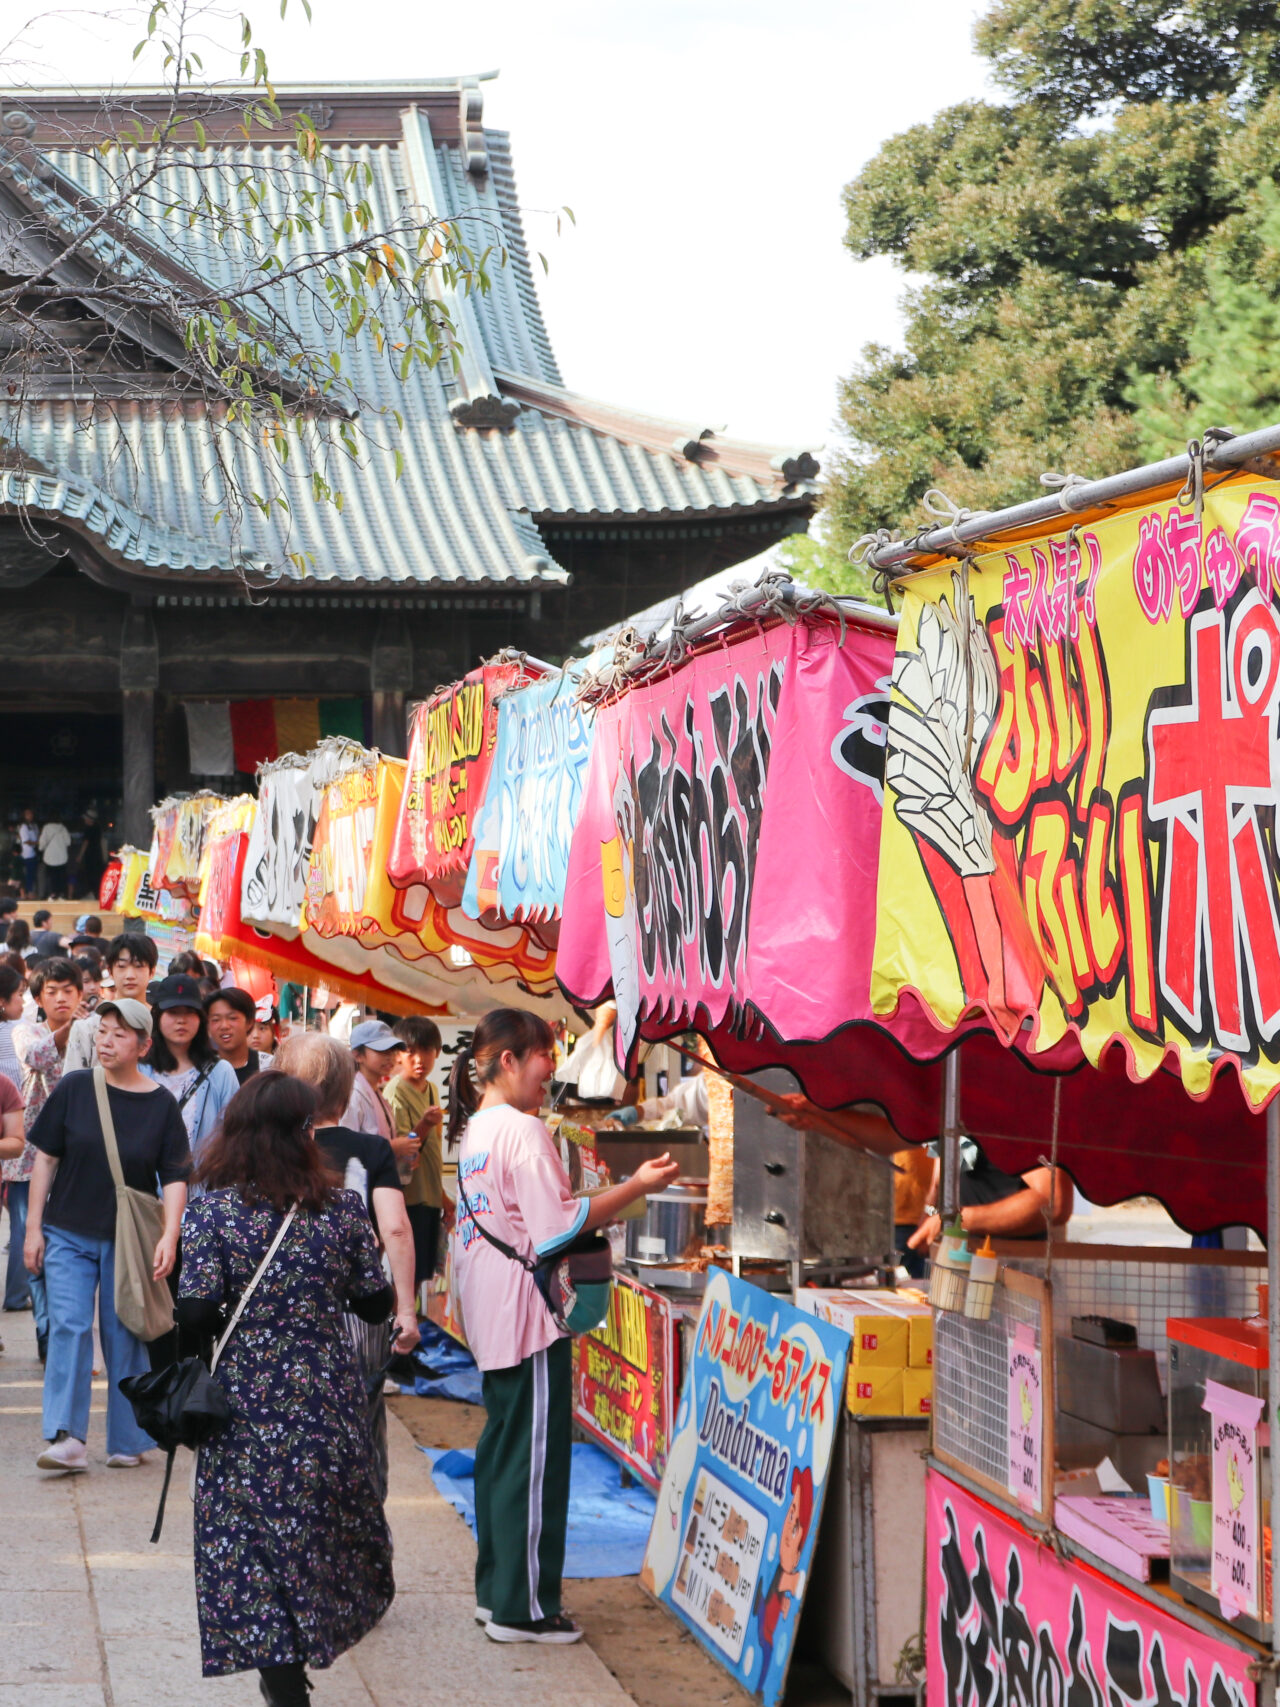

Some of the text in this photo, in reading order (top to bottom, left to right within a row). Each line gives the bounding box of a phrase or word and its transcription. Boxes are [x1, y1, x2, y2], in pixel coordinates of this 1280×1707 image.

[1002, 532, 1102, 654] 大人気!
[1133, 492, 1280, 625] めちゃう
[700, 1380, 789, 1499] Dondurma
